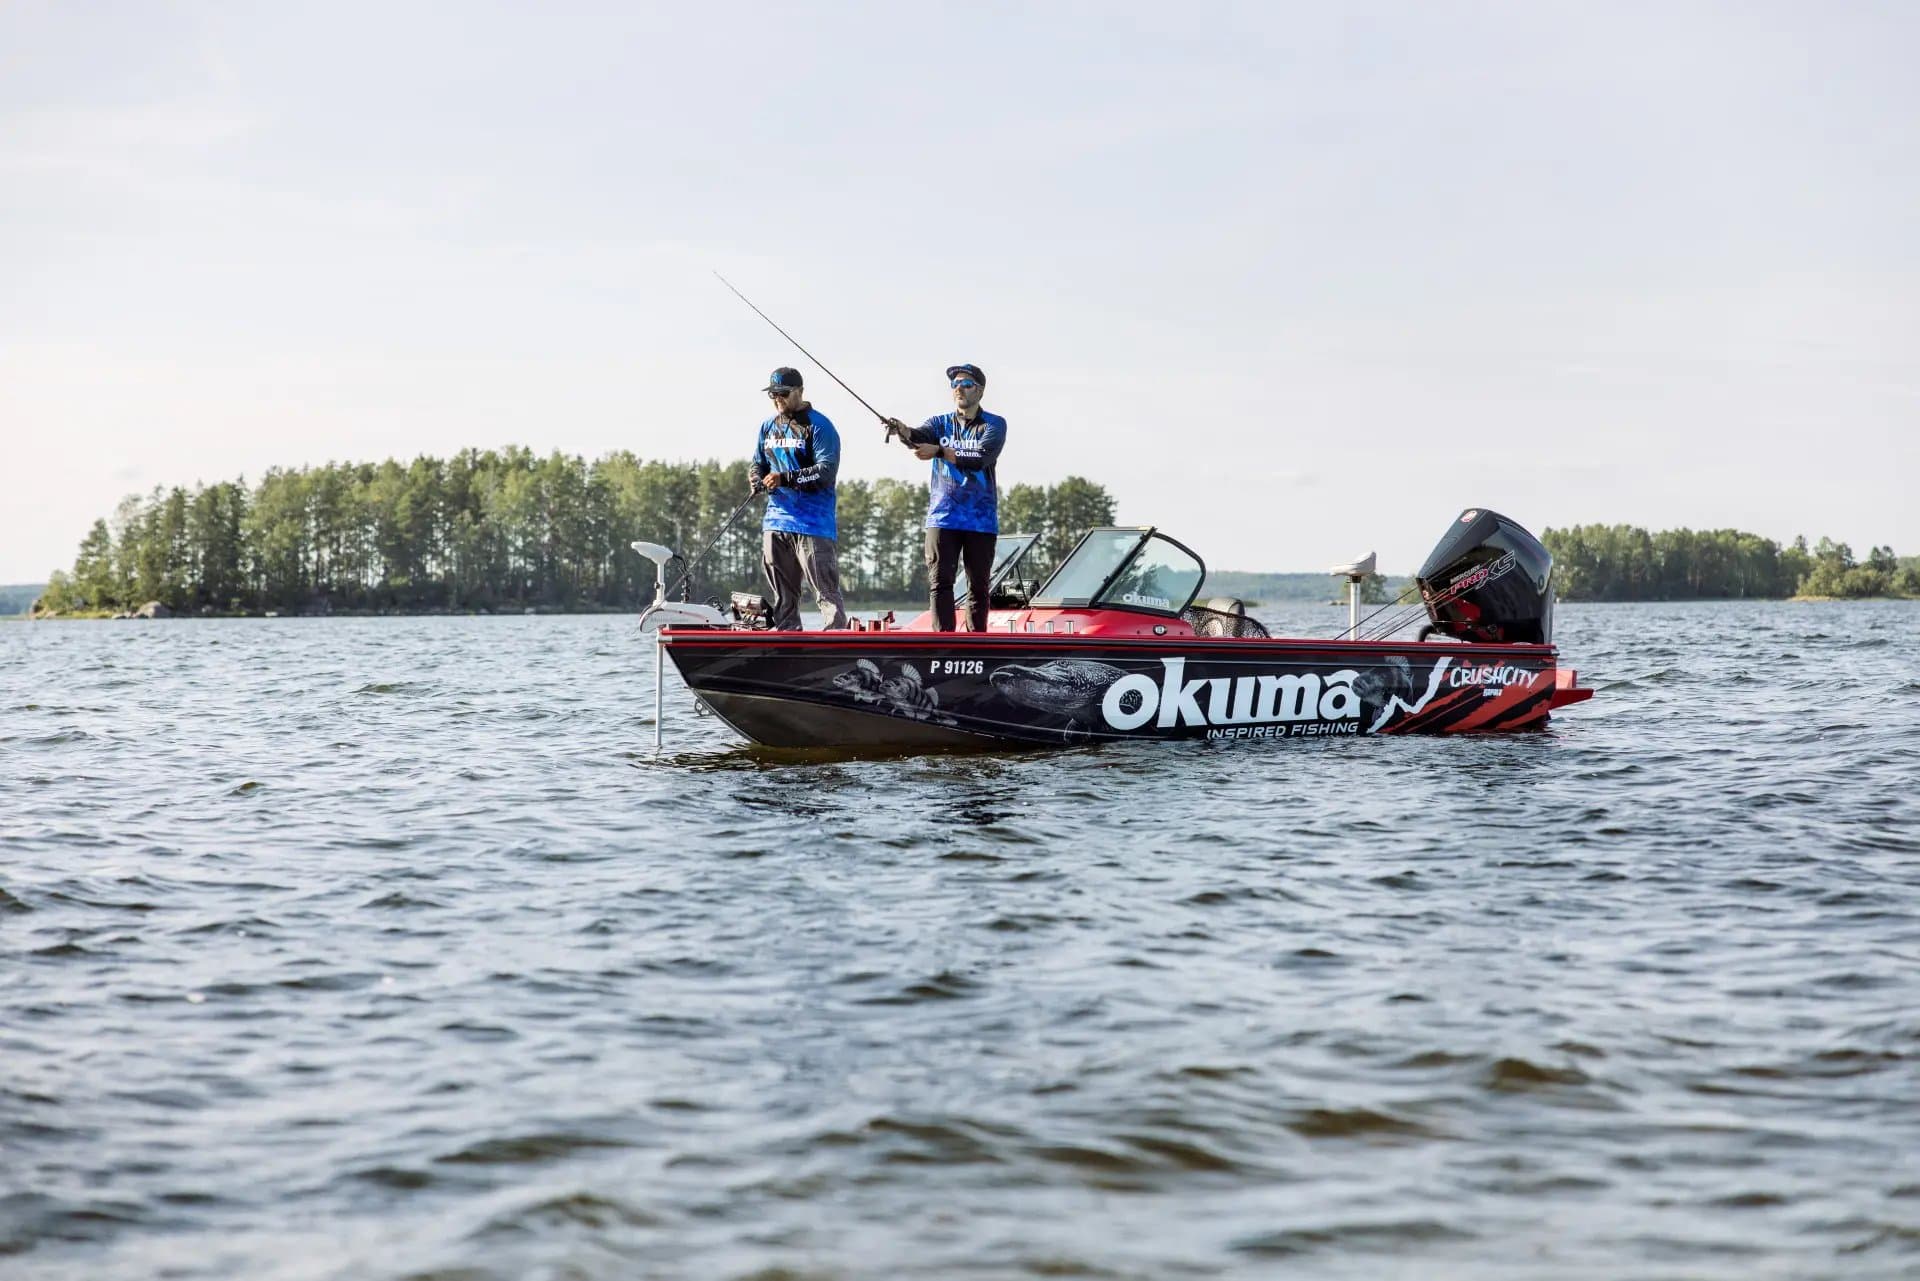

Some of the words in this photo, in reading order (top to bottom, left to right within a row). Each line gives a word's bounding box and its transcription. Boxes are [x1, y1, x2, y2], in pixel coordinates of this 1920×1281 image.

[1123, 592, 1170, 609] okuma
[931, 660, 941, 674] P
[944, 660, 984, 674] 91126
[1102, 657, 1361, 731] okuma
[1207, 725, 1286, 740] INSPIRED
[1291, 722, 1359, 736] FISHING
